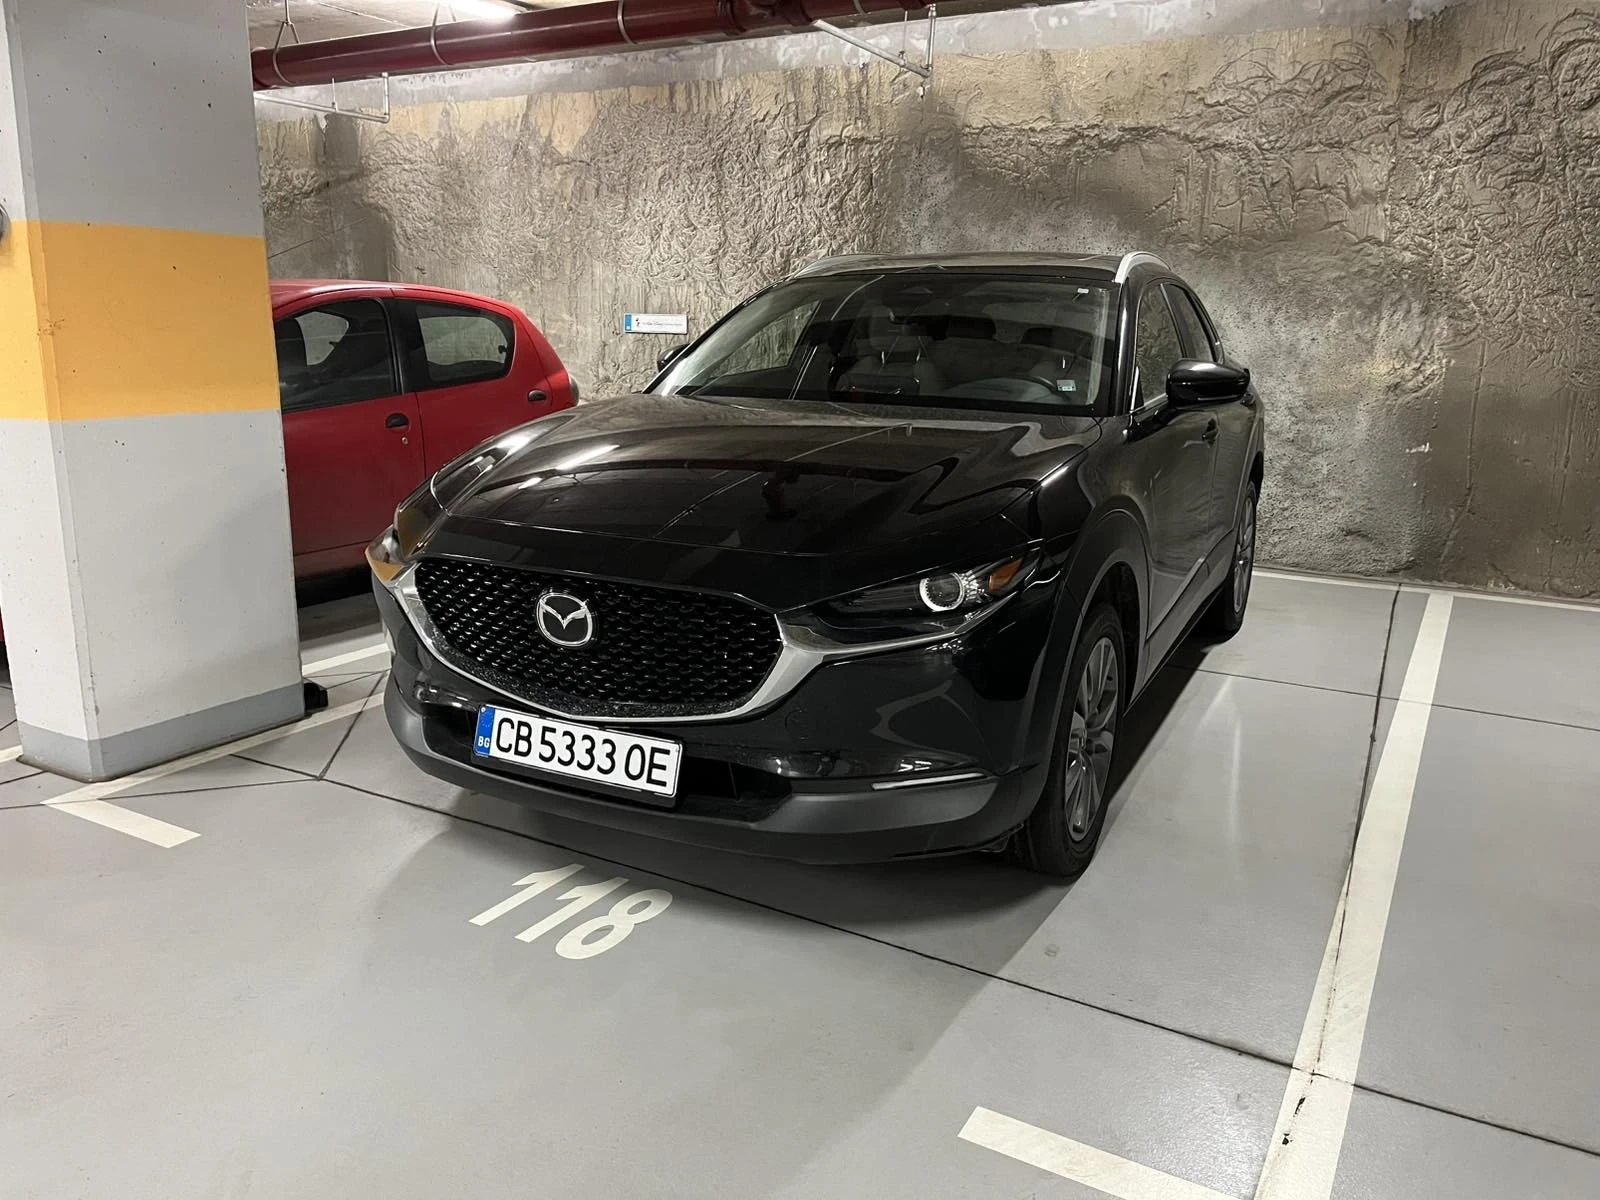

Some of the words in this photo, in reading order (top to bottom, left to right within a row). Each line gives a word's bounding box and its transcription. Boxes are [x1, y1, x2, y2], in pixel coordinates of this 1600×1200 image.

[478, 736, 490, 748] BG
[496, 717, 532, 757] CB
[538, 726, 616, 775] 5333
[624, 743, 671, 787] OE
[468, 863, 673, 960] 118
